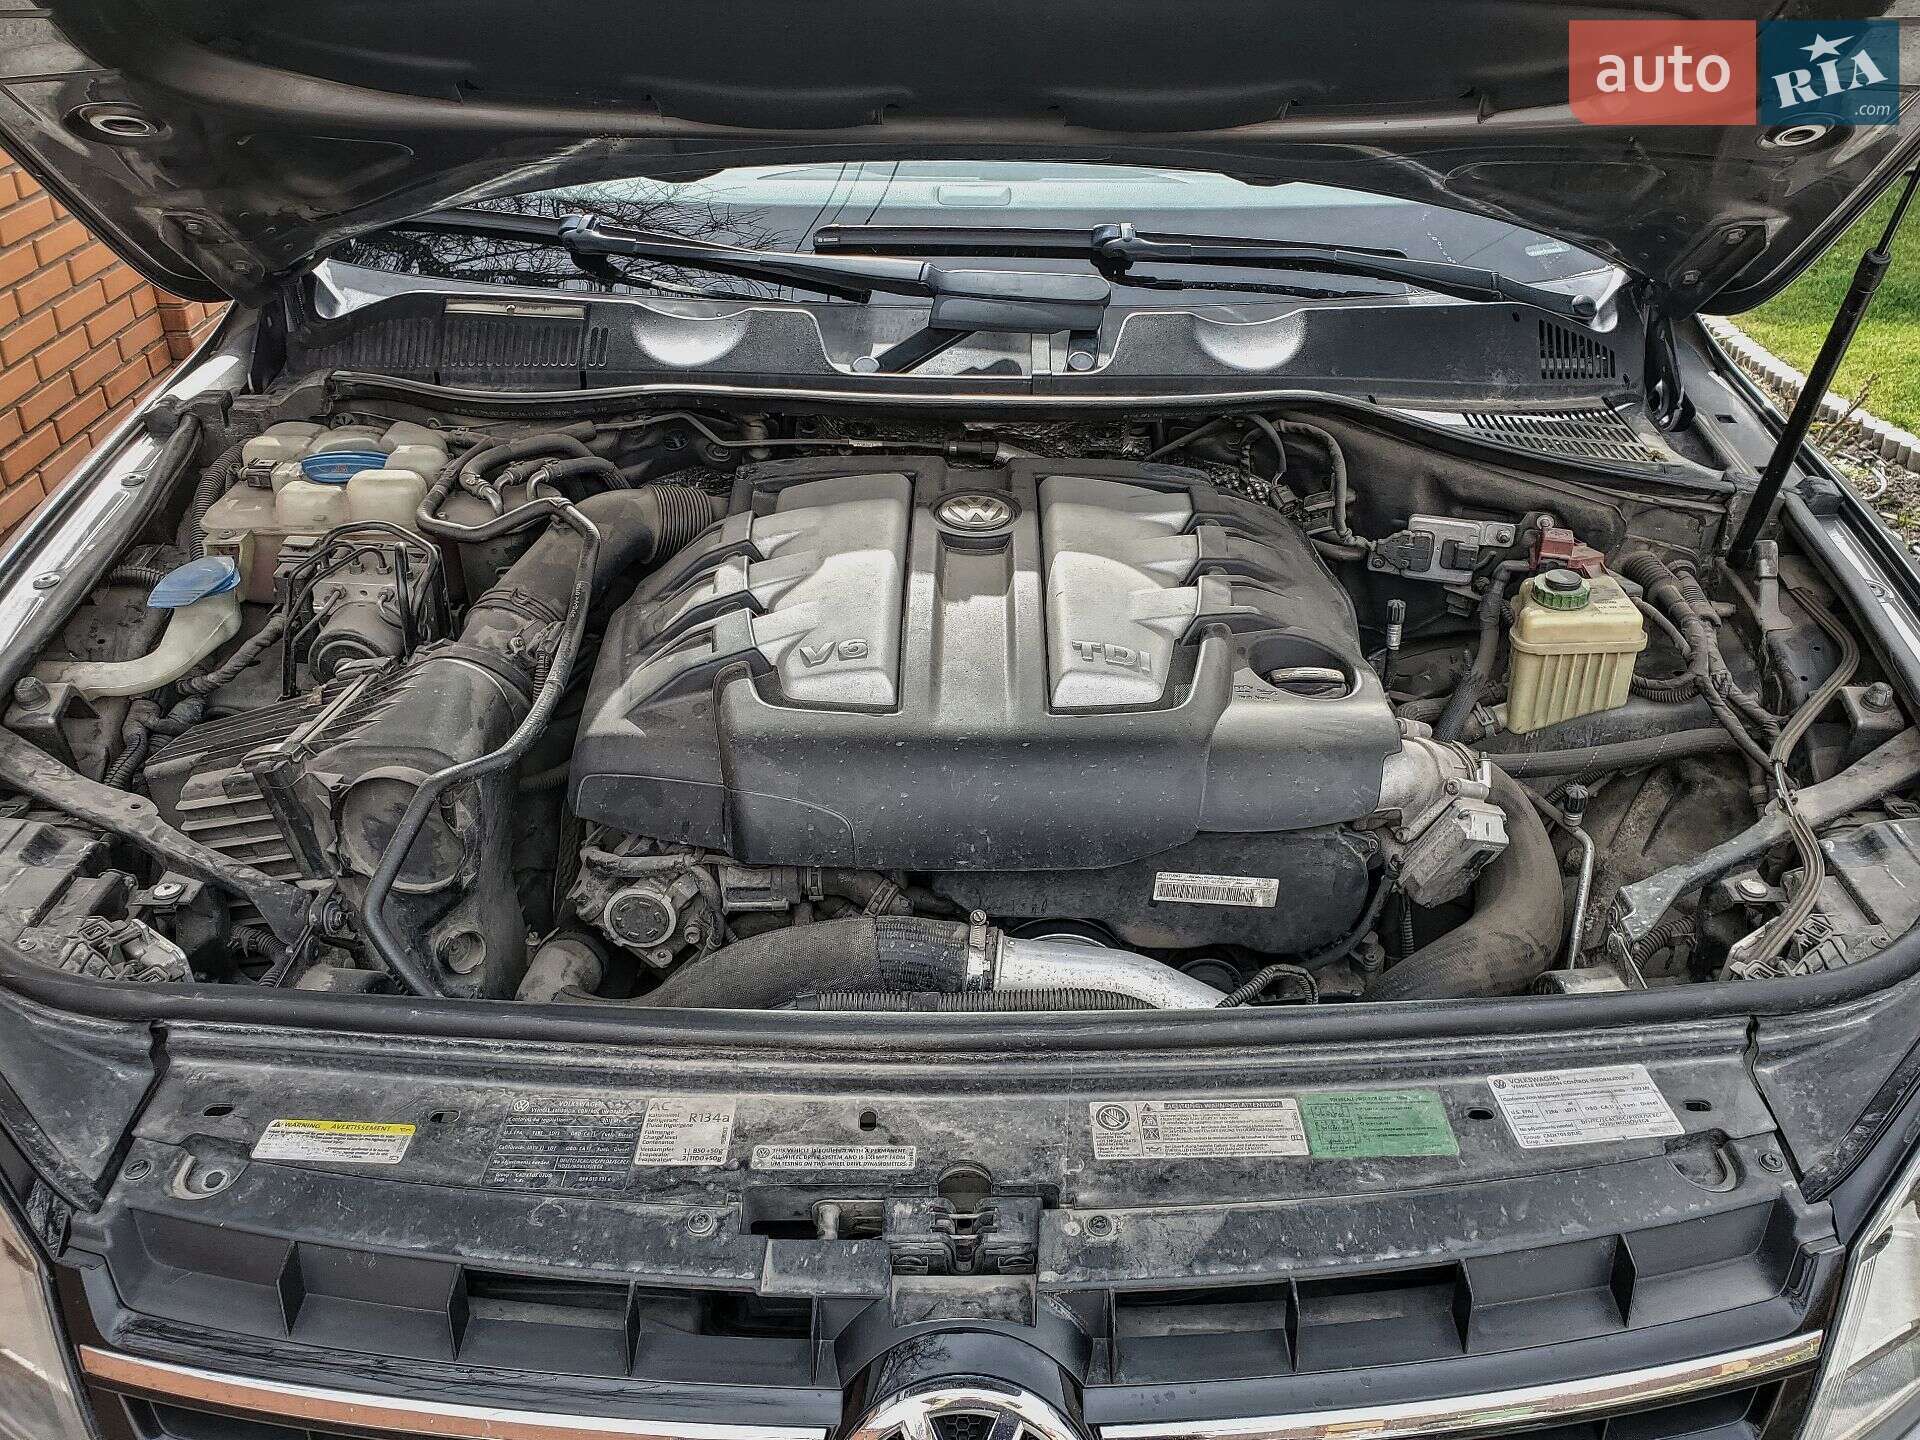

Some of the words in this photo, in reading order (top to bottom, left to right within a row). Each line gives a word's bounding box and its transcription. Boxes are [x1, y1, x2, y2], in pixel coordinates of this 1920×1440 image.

[800, 638, 868, 668] V6
[1070, 640, 1152, 672] TDI
[1508, 1075, 1560, 1084] VOLKSWAGEN
[650, 1102, 672, 1111] AC
[688, 1112, 730, 1123] R134a
[284, 1121, 320, 1129] WARNING
[330, 1123, 392, 1132] AVERTISSEMENT
